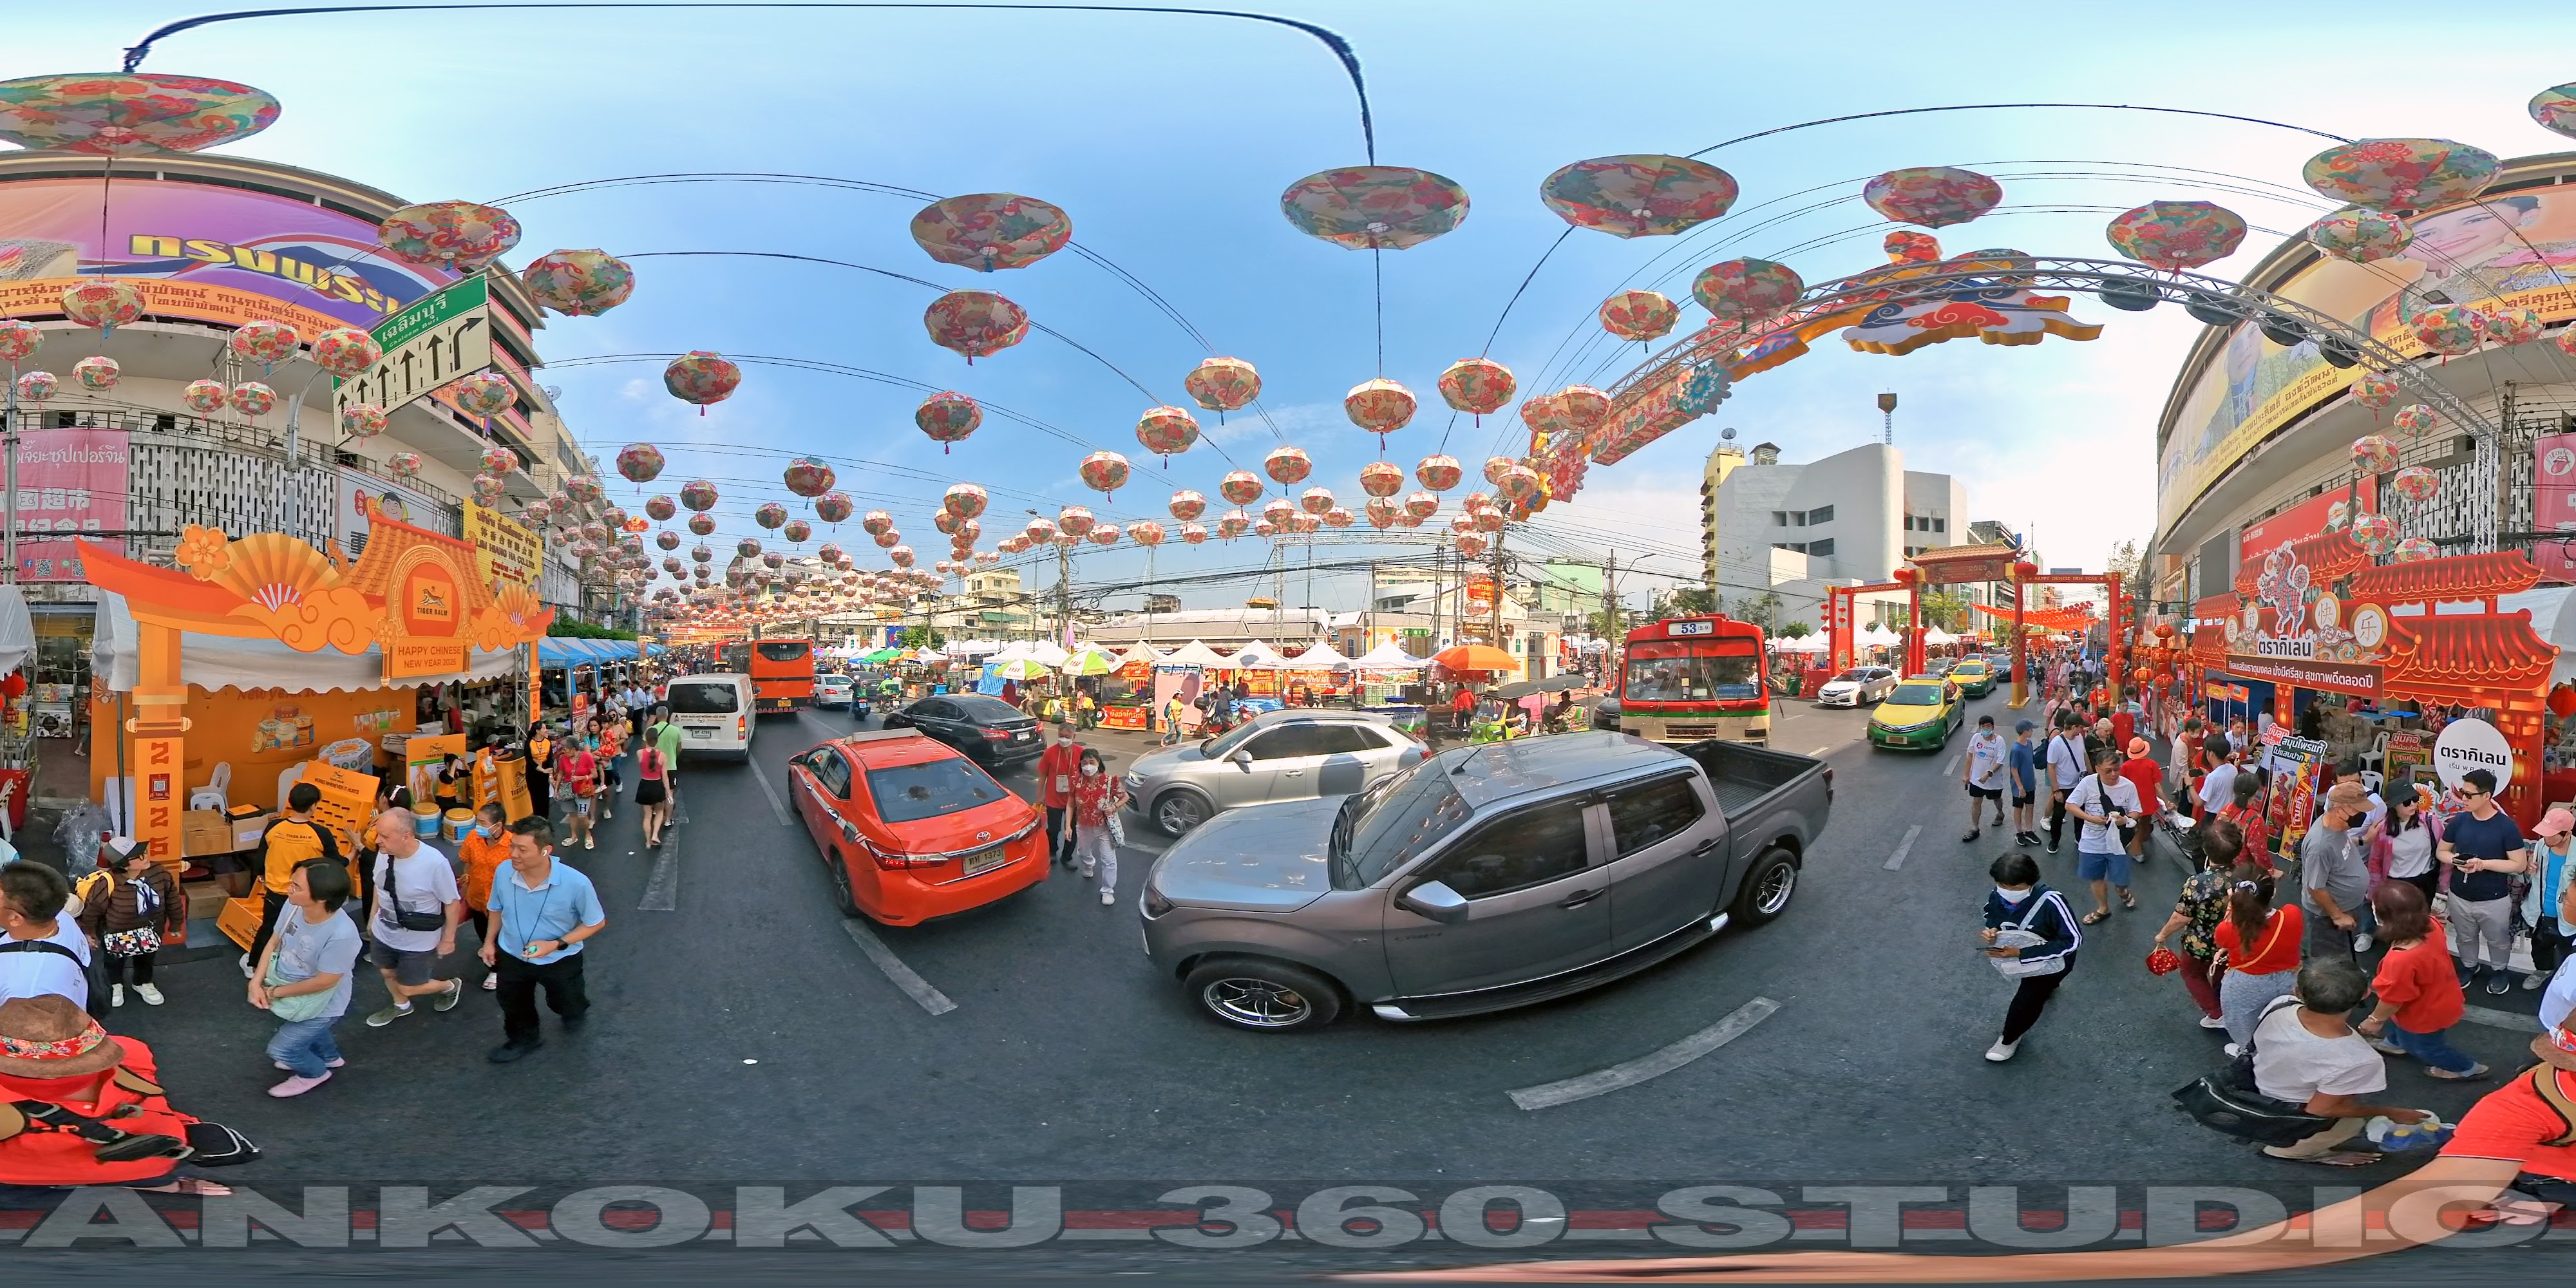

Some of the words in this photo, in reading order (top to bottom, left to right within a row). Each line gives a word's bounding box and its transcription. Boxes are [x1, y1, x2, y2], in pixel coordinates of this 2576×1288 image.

[382, 293, 448, 343] เฉลิมบุรี
[389, 327, 419, 348] Chaloem
[422, 317, 439, 329] Buri
[1681, 623, 1697, 634] 53
[2360, 615, 2377, 641] 乐
[398, 646, 428, 656] HAPPY
[430, 646, 462, 655] CHINESE
[2258, 635, 2311, 657] ตรากิเลน
[404, 660, 422, 668] NEW
[424, 659, 441, 667] YEAR
[2273, 663, 2304, 683] มั่งมีศรีสุข
[2305, 670, 2373, 688] สุขภาพดีตลอดปี
[2281, 737, 2325, 754] สมุนไพรแท้
[2392, 732, 2419, 744] ชุ่มคอ
[2273, 746, 2304, 762] ไม่แสบปาก
[2441, 746, 2506, 766] ตรากิเลน
[984, 849, 1001, 860] 1373
